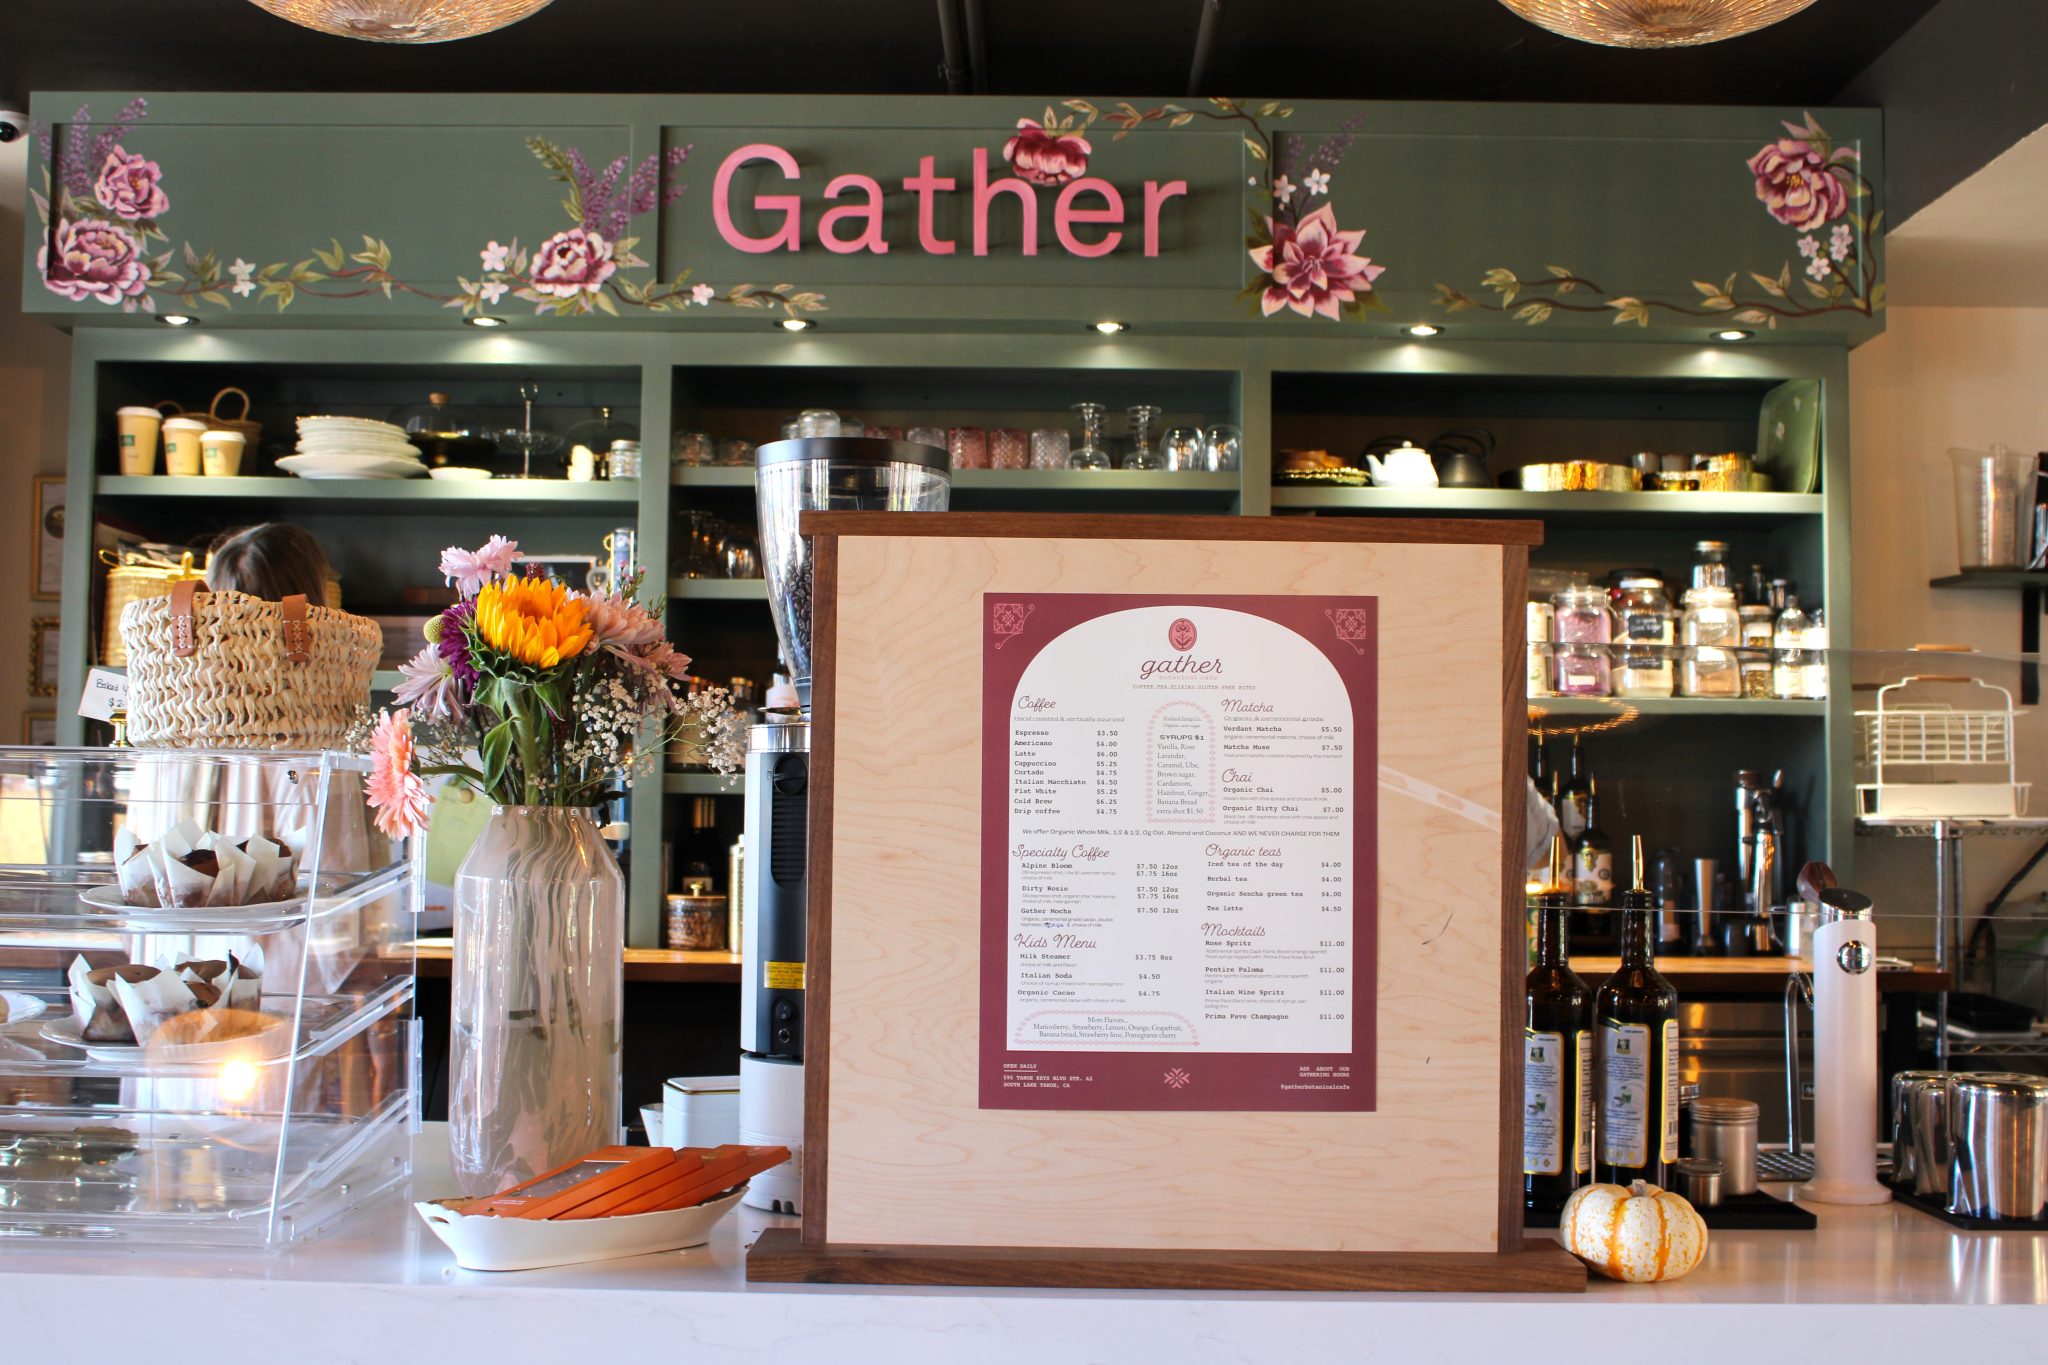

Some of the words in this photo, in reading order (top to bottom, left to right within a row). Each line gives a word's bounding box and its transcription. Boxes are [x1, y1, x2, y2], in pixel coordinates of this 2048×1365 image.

[712, 142, 1188, 258] Gather
[1139, 654, 1223, 680] gather
[1018, 695, 1056, 713] Coffee
[1220, 698, 1274, 713] Matcha
[1221, 767, 1254, 783] Chai
[1012, 843, 1068, 862] Specialty
[1071, 844, 1110, 862] Coffee
[1205, 843, 1256, 860] Organic
[1258, 846, 1282, 857] teas
[1200, 922, 1266, 937] Mocktails
[1013, 932, 1048, 948] Kids
[1052, 932, 1097, 949] Menu
